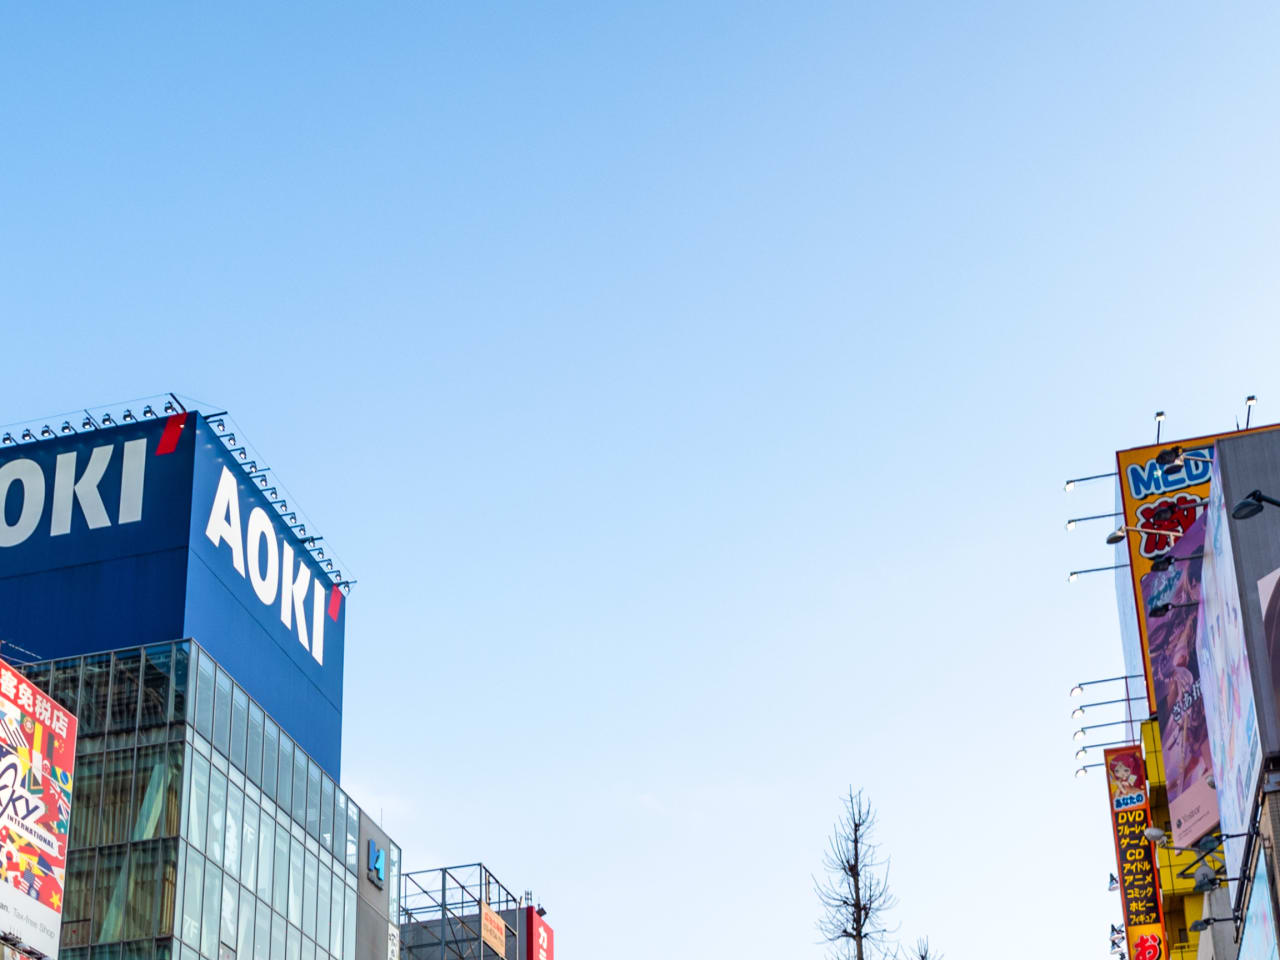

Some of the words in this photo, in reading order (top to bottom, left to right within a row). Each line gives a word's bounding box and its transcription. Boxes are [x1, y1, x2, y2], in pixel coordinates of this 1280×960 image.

[205, 465, 326, 666] AOKI
[1115, 793, 1144, 810] あなたの
[1118, 810, 1144, 824] DVD
[7, 814, 55, 849] INTERNATIONAL
[1126, 849, 1144, 861] CD
[1123, 861, 1150, 873] アイドル
[1124, 873, 1152, 886] アニメ
[1129, 901, 1154, 912] ホビー
